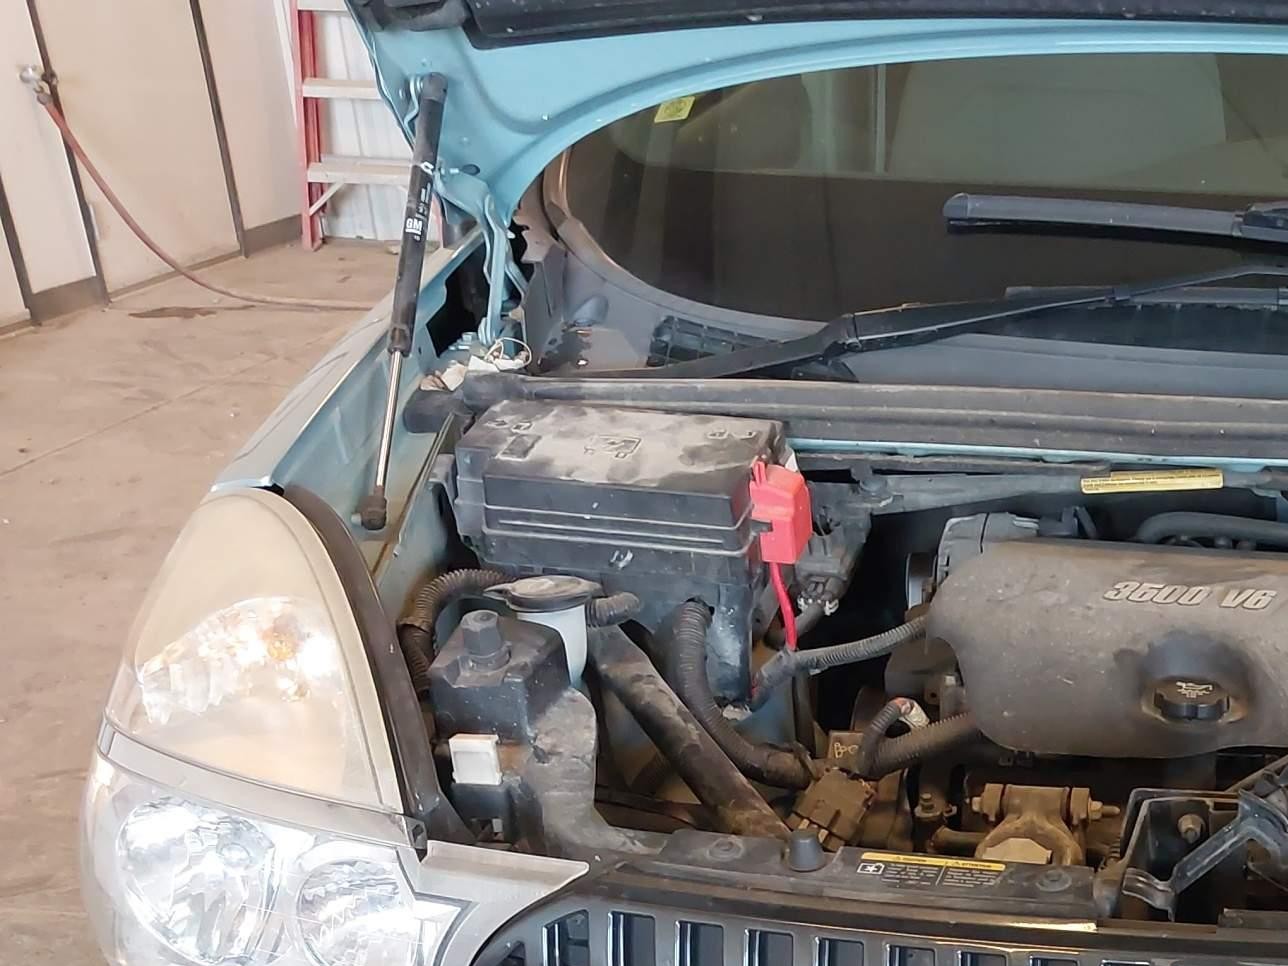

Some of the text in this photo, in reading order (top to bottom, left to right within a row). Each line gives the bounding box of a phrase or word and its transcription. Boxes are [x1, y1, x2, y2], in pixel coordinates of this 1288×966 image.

[405, 217, 423, 232] GM
[1102, 580, 1278, 610] 3500 V6
